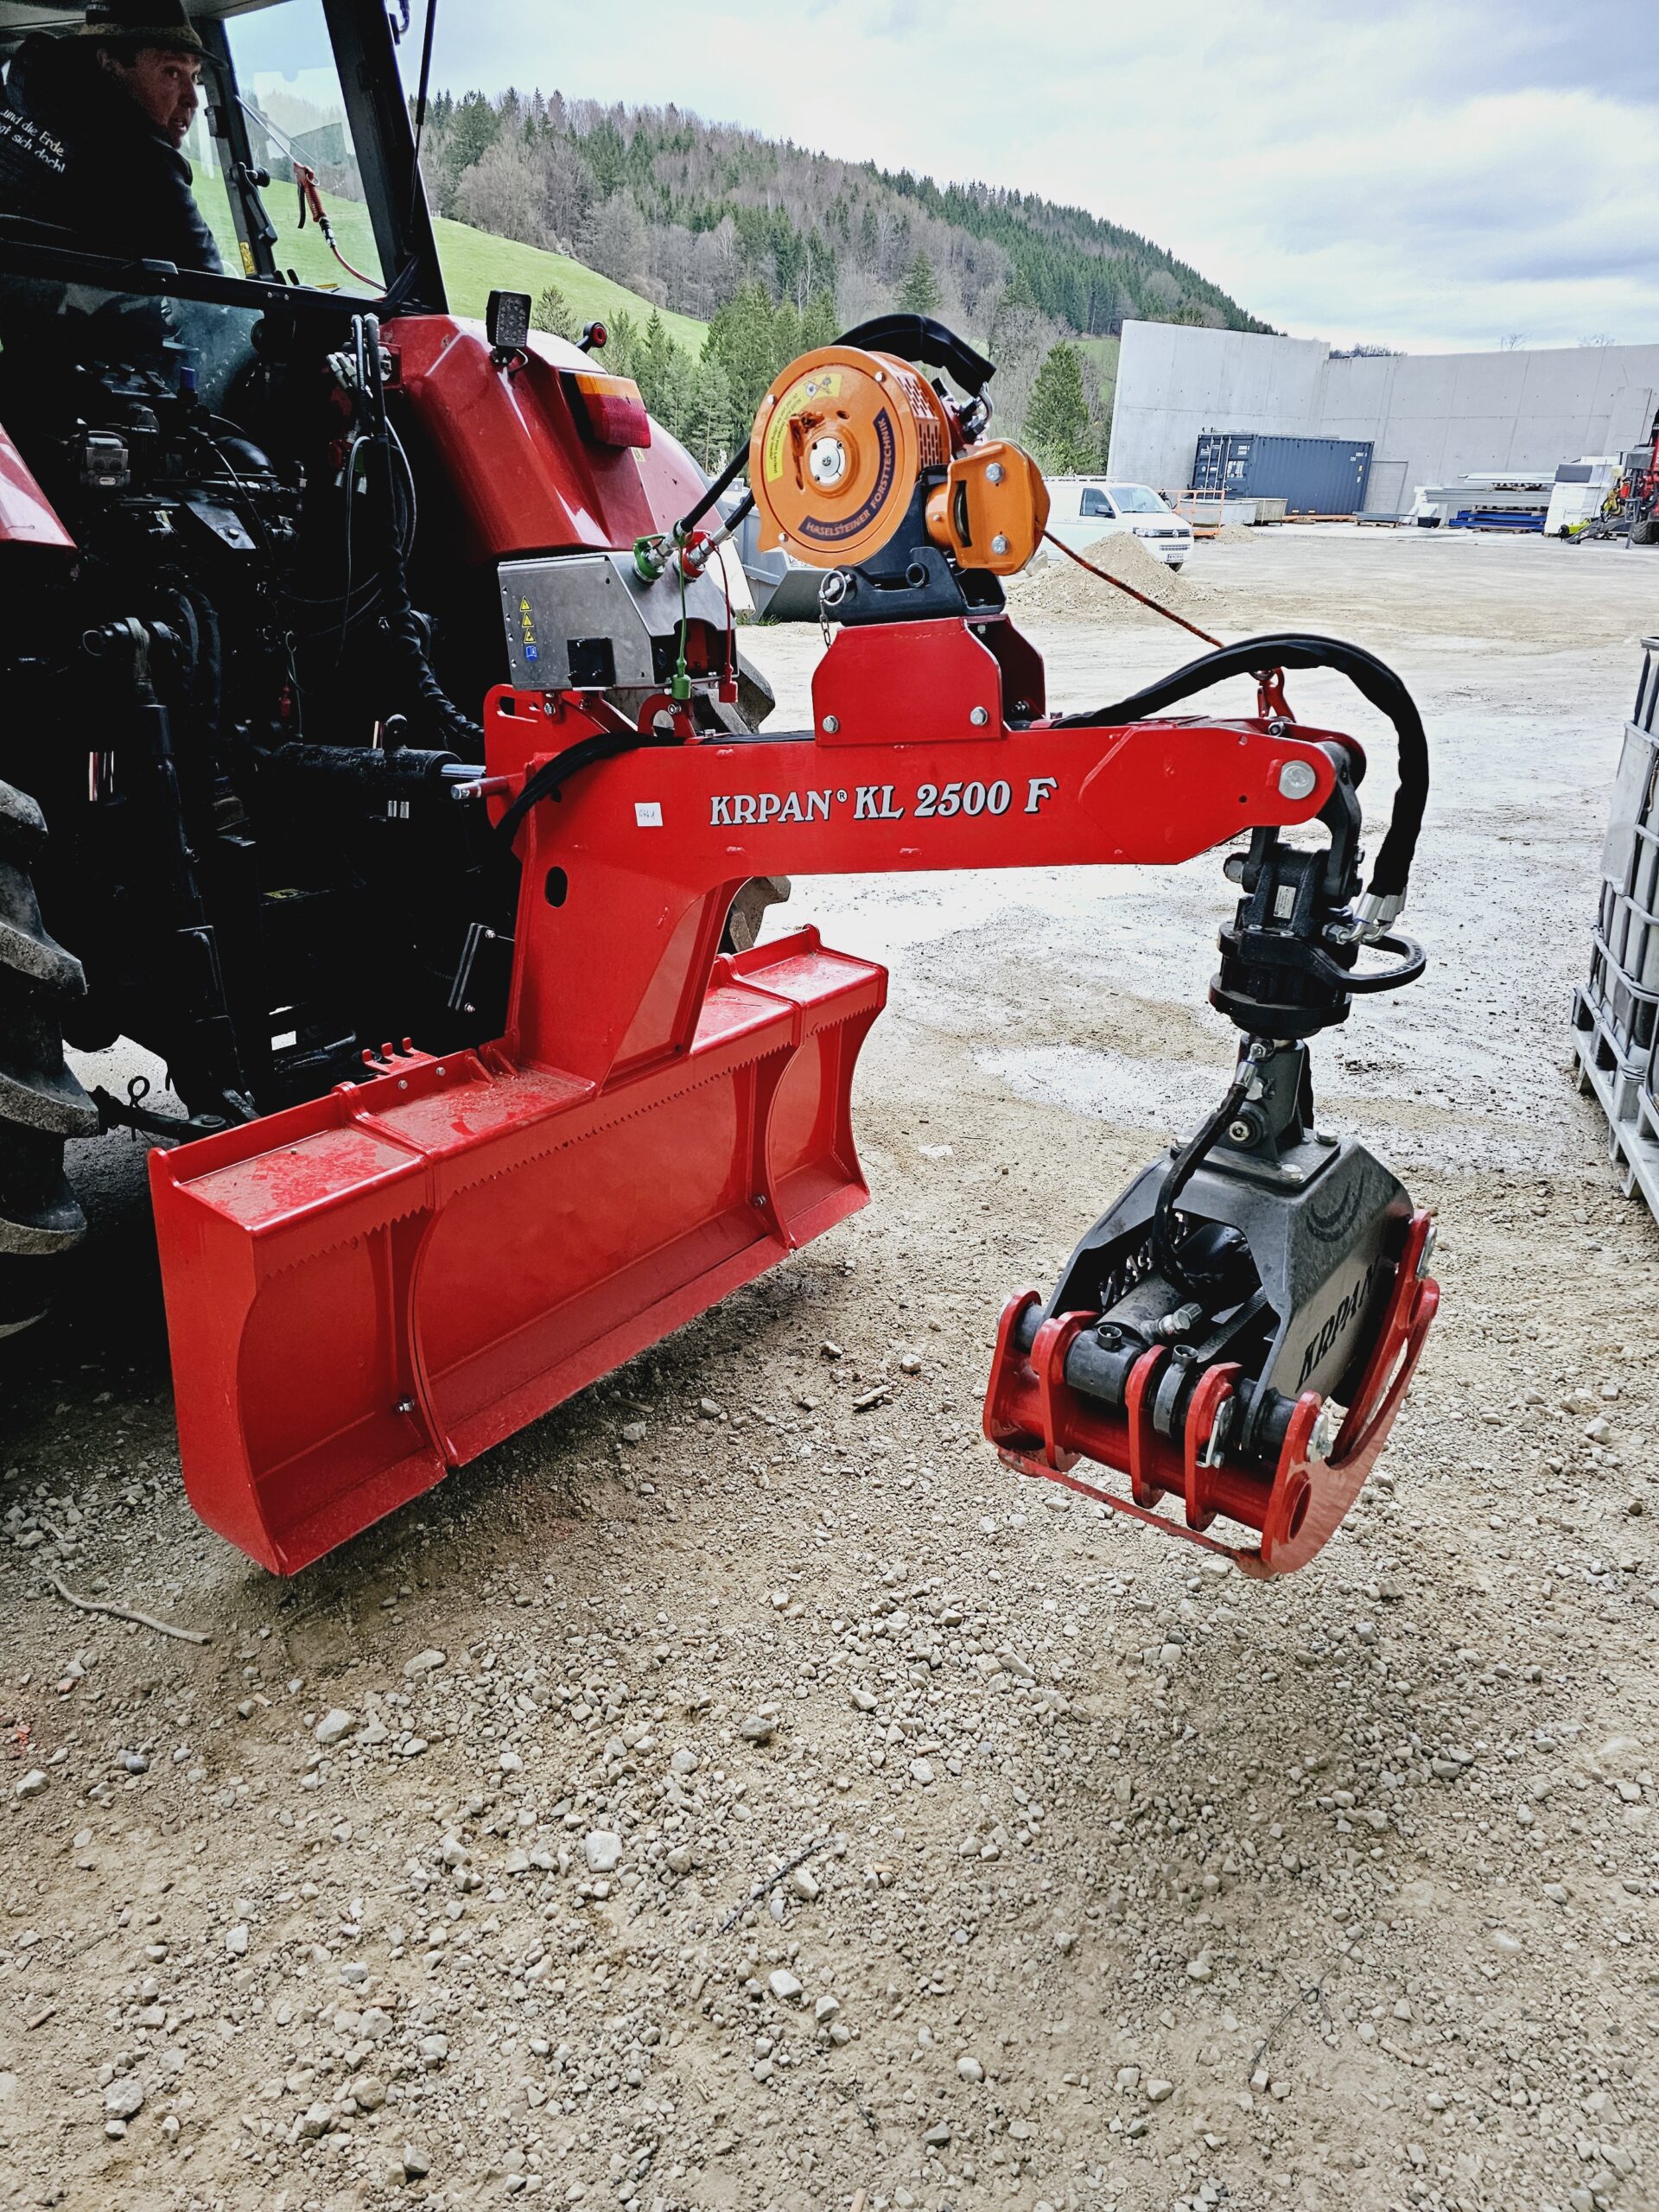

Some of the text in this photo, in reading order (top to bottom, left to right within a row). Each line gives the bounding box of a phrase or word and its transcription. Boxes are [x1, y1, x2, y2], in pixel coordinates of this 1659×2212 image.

[11, 134, 33, 150] sich
[22, 121, 38, 137] die
[39, 130, 65, 157] Erde
[805, 417, 892, 537] HASELSTEINER FORSTTECHNIK
[853, 785, 905, 820] KL
[913, 780, 1013, 817] 2500
[1024, 776, 1058, 814] F
